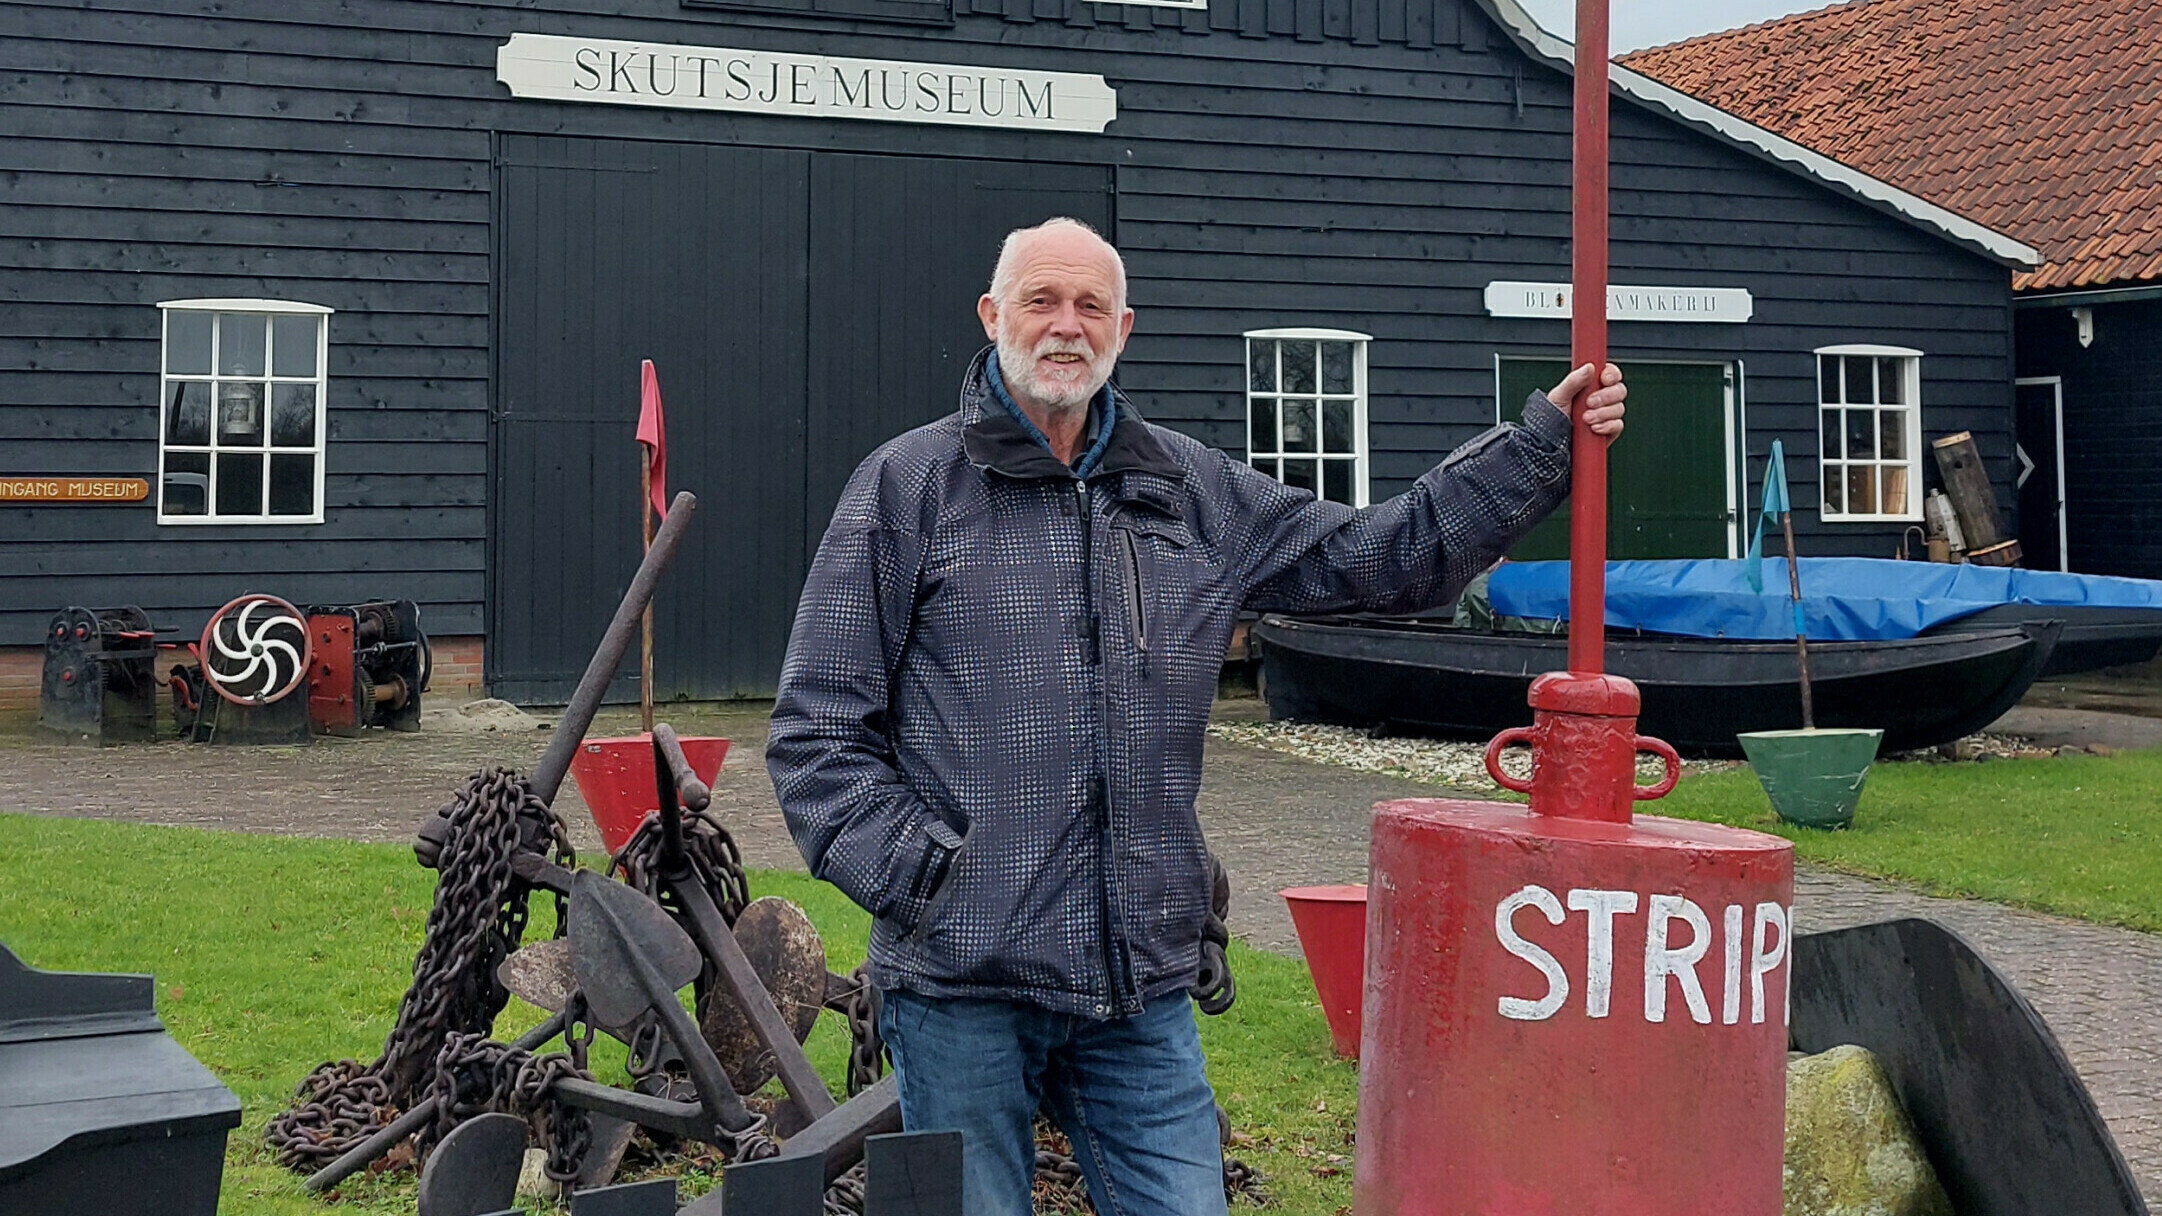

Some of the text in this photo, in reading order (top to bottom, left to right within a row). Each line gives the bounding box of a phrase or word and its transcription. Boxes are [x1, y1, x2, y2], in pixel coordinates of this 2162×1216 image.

[1525, 290, 1716, 312] BLONMAKERIJ
[68, 482, 139, 497] MUSEUM
[1495, 884, 1794, 1027] STRIP
